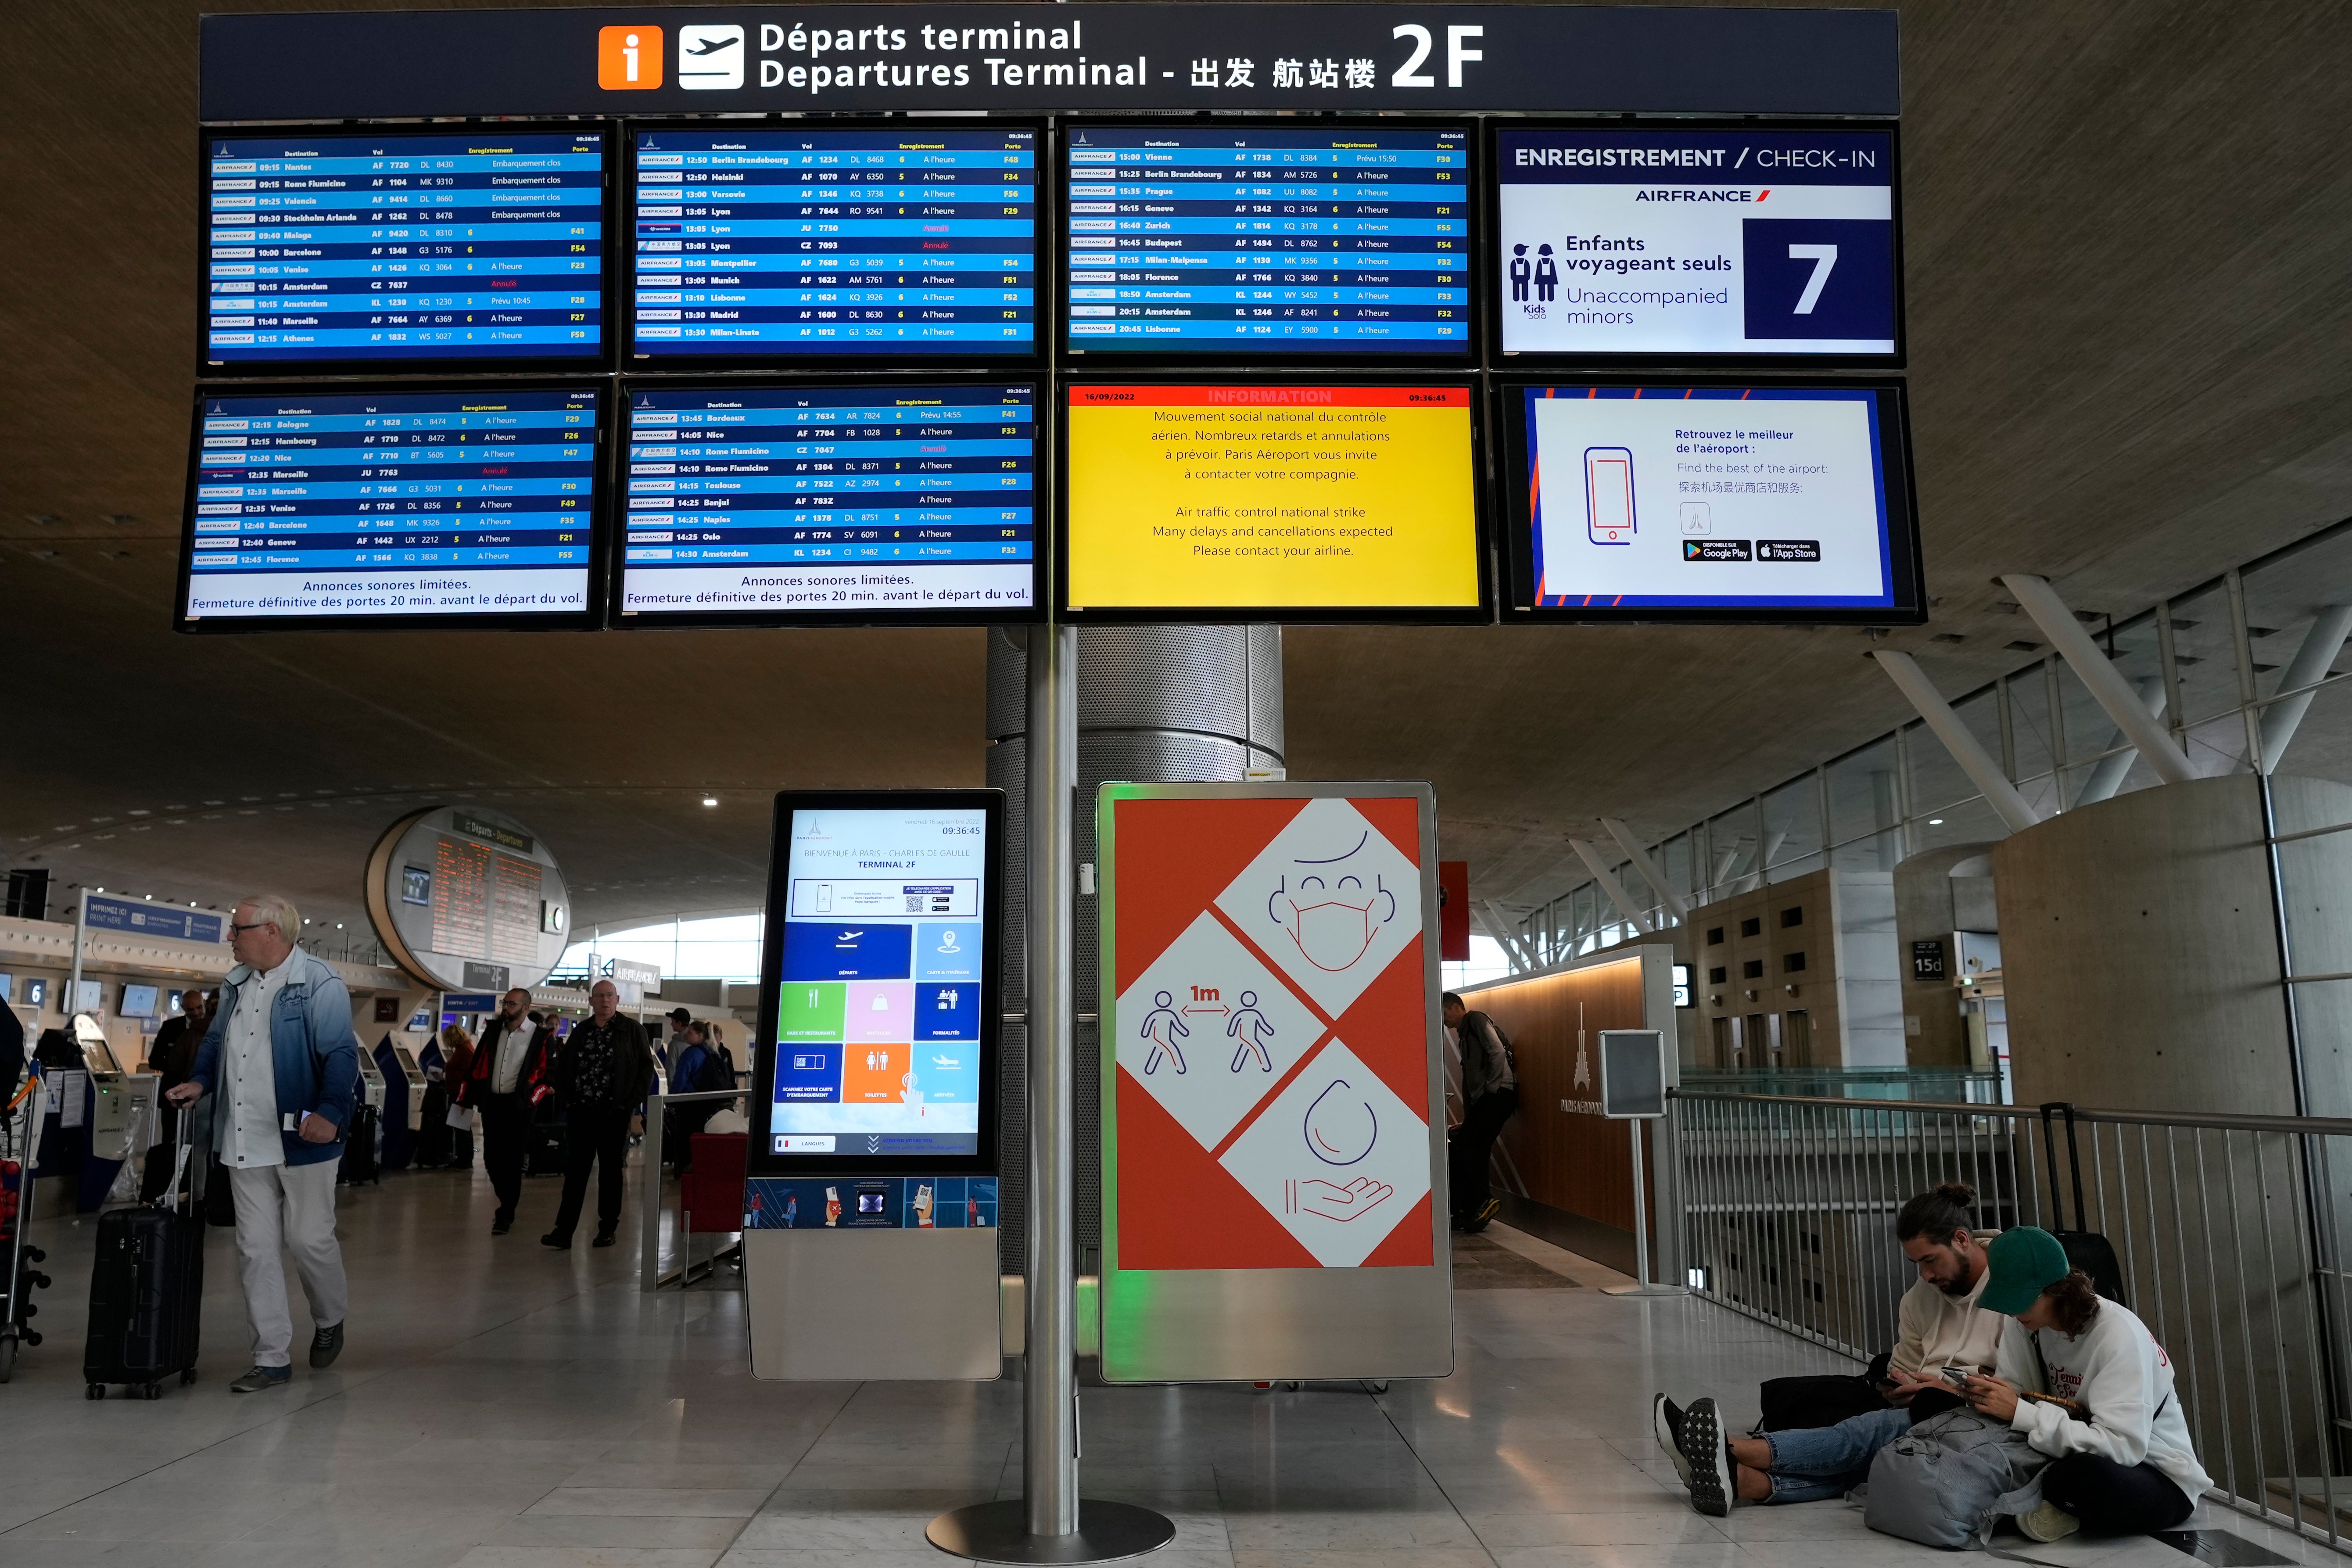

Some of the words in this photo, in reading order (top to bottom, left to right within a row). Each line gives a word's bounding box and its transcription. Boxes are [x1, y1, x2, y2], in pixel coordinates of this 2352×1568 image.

[761, 23, 906, 58] Départs
[921, 21, 1080, 50] terminal
[1392, 24, 1483, 87] 2F
[761, 58, 969, 93] Departures
[984, 57, 1145, 85] Terminal
[1191, 58, 1255, 88] 出发
[1273, 58, 1375, 89] 航站楼
[1516, 149, 1725, 166] ENREGISTREMENT
[1757, 150, 1874, 167] CHECK-IN
[1636, 191, 1751, 201] AIRFRANCE
[1145, 239, 1182, 248] Budapest
[1567, 235, 1644, 251] Enfants
[1567, 257, 1675, 275] voyageant
[1683, 255, 1731, 270] seuls
[1789, 244, 1837, 314] 7
[1568, 288, 1727, 308] Unaccompanied
[1524, 305, 1545, 314] Kids
[1568, 309, 1633, 323] minors
[1208, 389, 1332, 403] INFORMATION
[1154, 412, 1225, 421] Mouvement
[1230, 412, 1262, 421] social
[1267, 412, 1314, 421] national
[1319, 412, 1334, 421] du
[1338, 412, 1386, 422] contrôle
[1152, 430, 1190, 440] aérien.
[1195, 431, 1257, 440] Nombreux
[1262, 431, 1301, 440] retards
[1322, 431, 1389, 441] annulations
[1676, 430, 1731, 438] Retrouvez
[1736, 430, 1744, 438] le
[1749, 430, 1793, 439] meilleur
[1166, 449, 1172, 459] à
[1176, 449, 1220, 462] prévoir.
[1226, 449, 1252, 459] Paris
[1257, 449, 1309, 462] Aéroport
[1346, 450, 1377, 459] invite
[1677, 444, 1689, 452] de
[1694, 444, 1748, 455] l'aéroport
[1185, 469, 1190, 478] à
[1290, 469, 1358, 482] compagnie.
[1678, 463, 1701, 472] Find
[1706, 463, 1722, 472] the
[1727, 463, 1749, 473] best
[1754, 464, 1764, 473] of
[1768, 464, 1785, 473] the
[1789, 464, 1828, 475] airport:
[1176, 507, 1192, 516] Air
[1197, 506, 1230, 517] traffic
[1235, 507, 1276, 517] control
[1282, 507, 1328, 517] national
[1334, 507, 1365, 517] strike
[1154, 527, 1185, 539] Many
[1190, 526, 1226, 539] delays
[1232, 526, 1253, 536] and
[1258, 526, 1334, 536] cancellations
[1340, 526, 1392, 538] expected
[1194, 545, 1230, 555] Please
[1236, 547, 1279, 555] contact
[1284, 548, 1310, 558] your
[1315, 545, 1353, 555] airline.
[1703, 549, 1731, 559] Google
[1732, 549, 1748, 559] Play
[1774, 549, 1794, 559] l'App
[742, 577, 802, 585] Annonces
[862, 574, 913, 584] limitées.
[628, 593, 691, 603] Fermeture
[697, 592, 755, 602] définitive
[761, 592, 781, 601] des
[787, 592, 826, 603] portes
[832, 591, 846, 600] 20
[852, 590, 877, 600] min.
[883, 592, 918, 600] avant
[924, 589, 933, 599] le
[939, 589, 980, 602] départ
[986, 589, 1000, 599] du
[1006, 588, 1028, 598] vol.
[91, 904, 118, 915] IMPRIMEZ
[90, 913, 105, 922] PRINT
[107, 915, 122, 925] HERE
[593, 965, 599, 977] 7
[1915, 958, 1942, 972] 15d
[32, 985, 41, 1003] 6
[1190, 985, 1219, 1001] 1m
[171, 995, 179, 1011] 6
[1561, 1098, 1603, 1116] PARISAÉROPOR
[2049, 1362, 2084, 1386] Tenni
